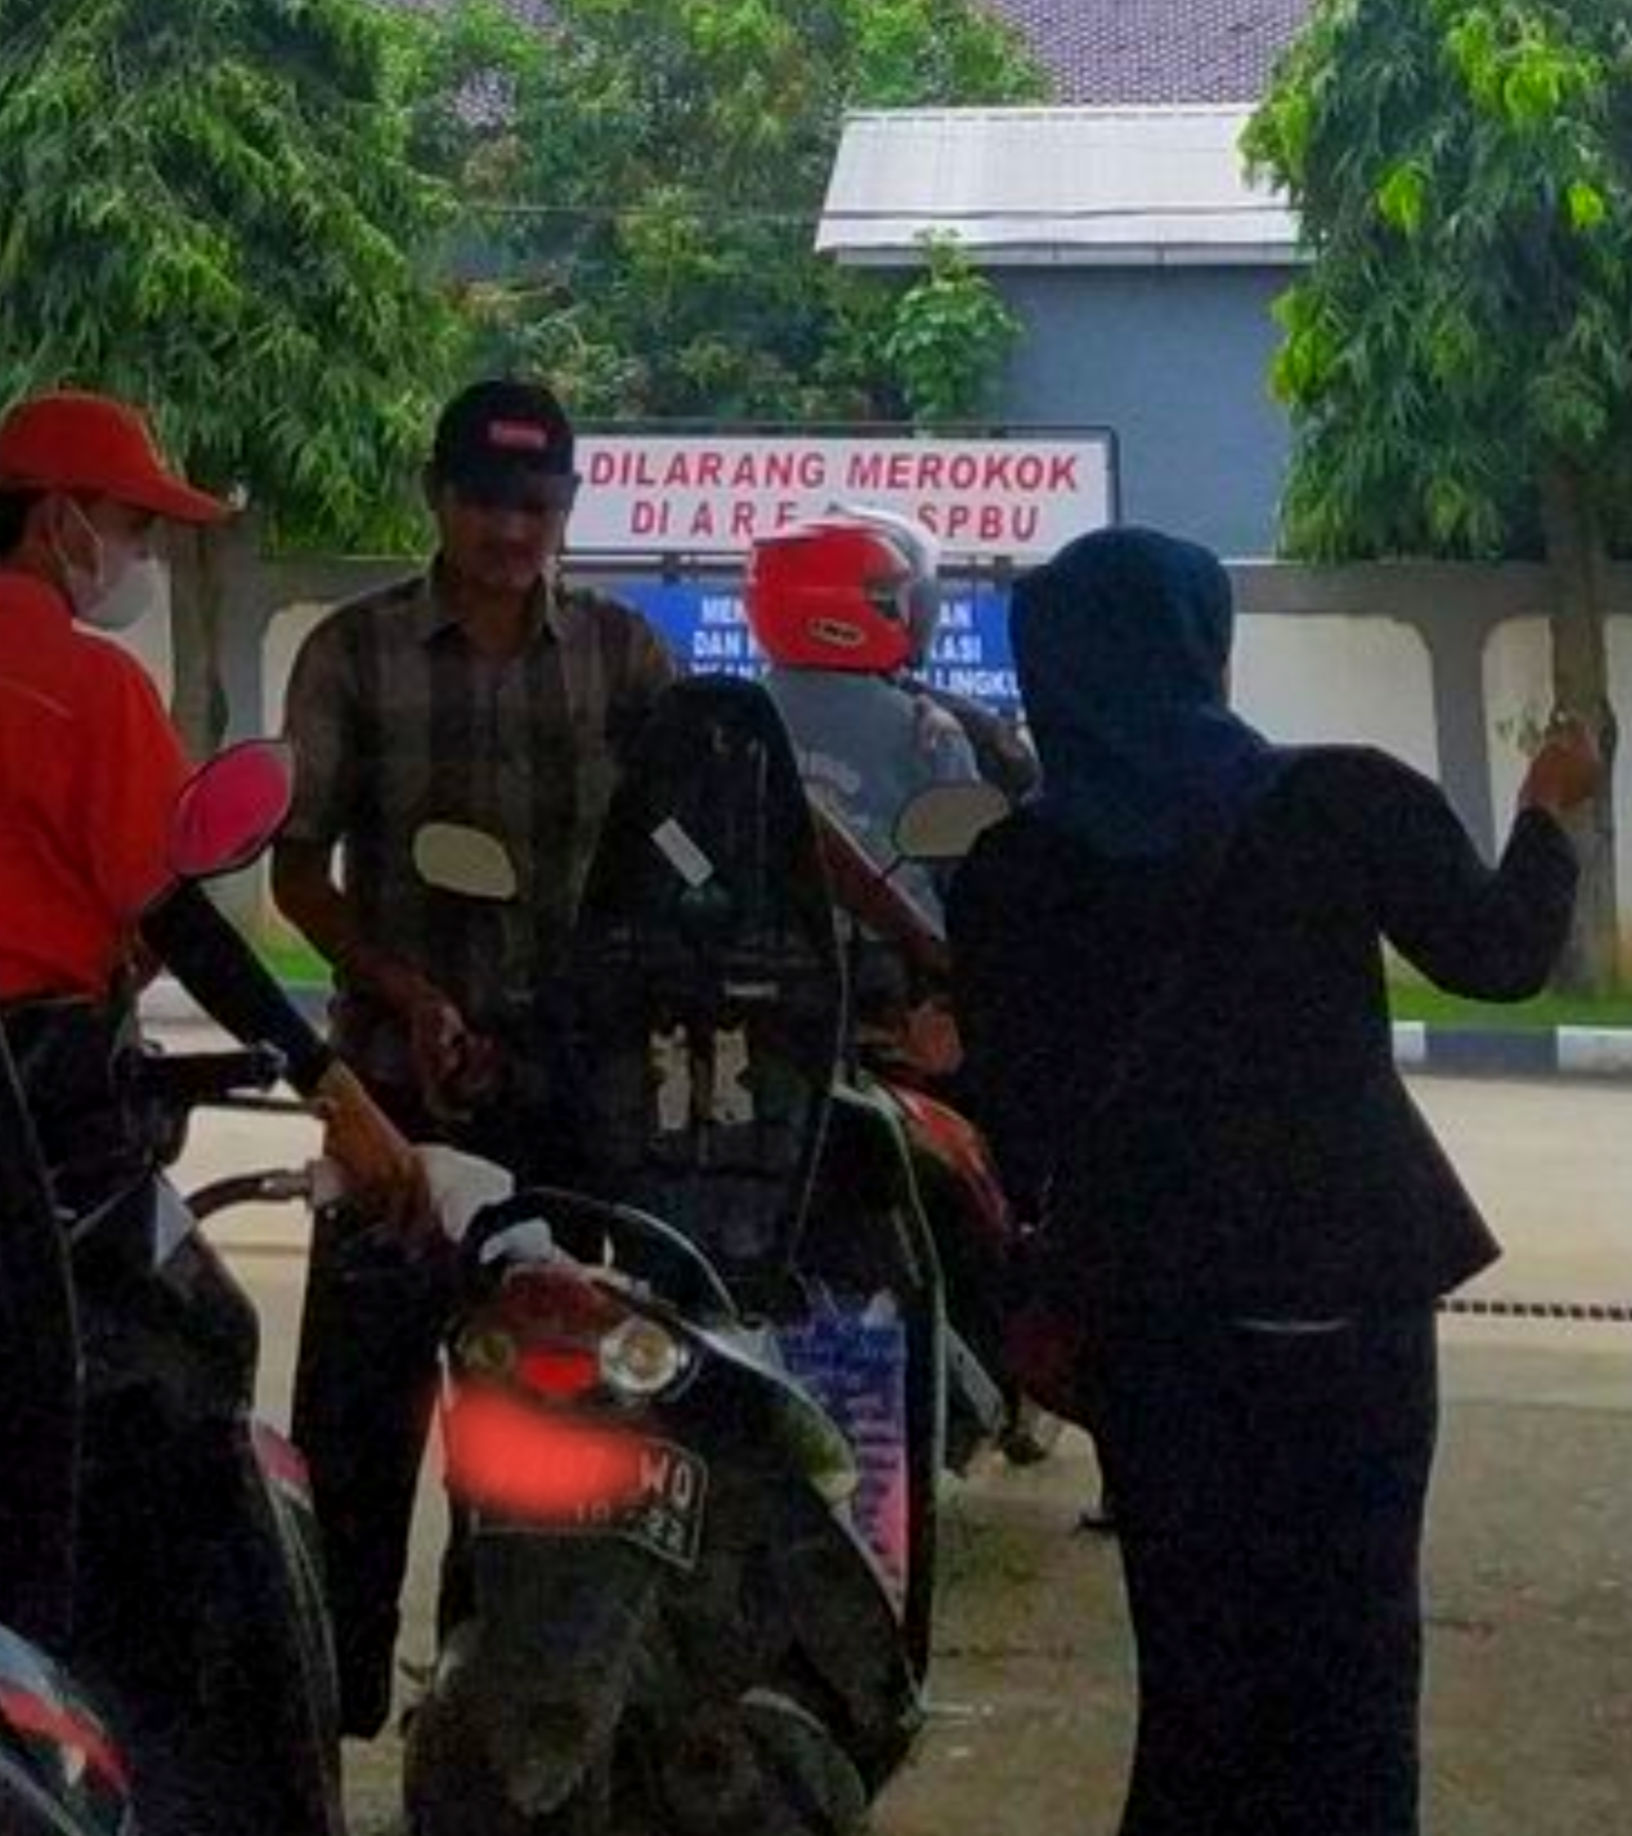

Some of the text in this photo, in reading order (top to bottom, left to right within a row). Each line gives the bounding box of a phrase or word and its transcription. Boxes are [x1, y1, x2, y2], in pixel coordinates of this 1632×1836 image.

[588, 450, 1079, 492] DILARANG MEROKOK
[630, 500, 668, 534] DI
[693, 630, 740, 658] DAN
